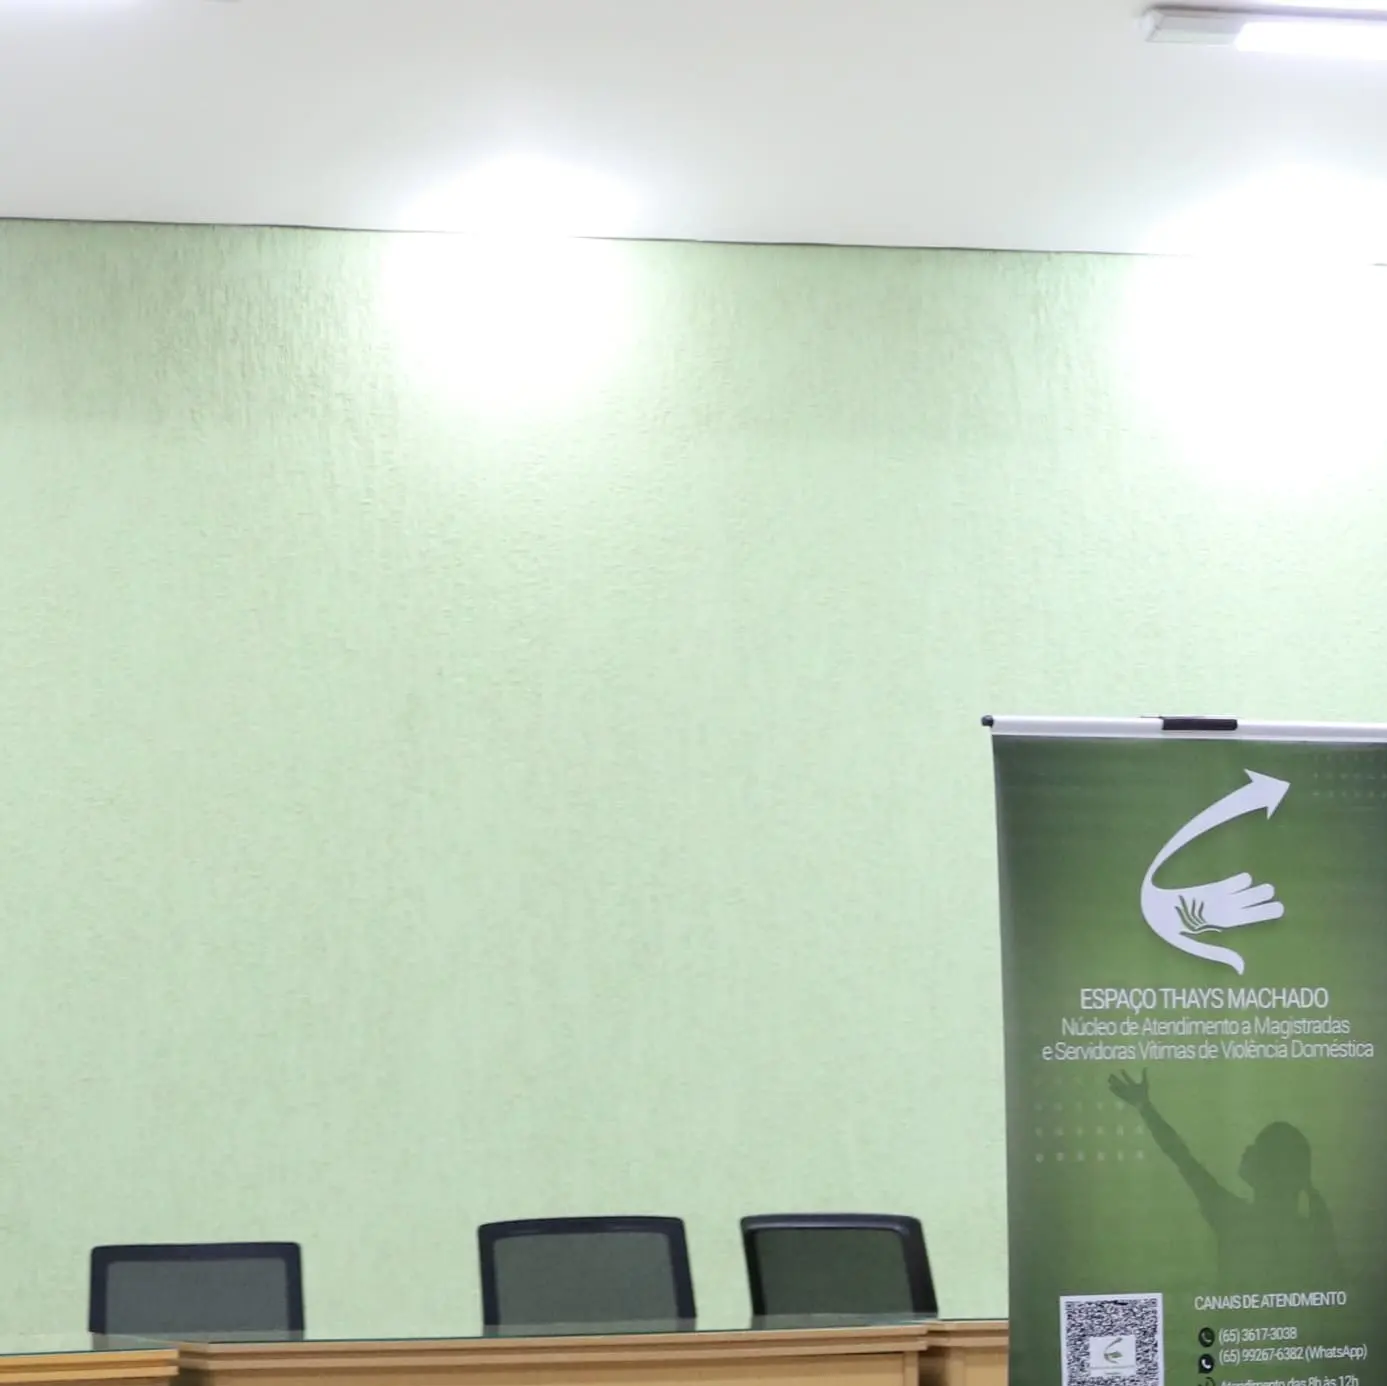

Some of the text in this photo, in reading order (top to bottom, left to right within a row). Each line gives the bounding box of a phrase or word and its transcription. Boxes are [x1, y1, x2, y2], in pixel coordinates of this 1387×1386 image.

[1080, 987, 1329, 1014] ESPAÇO THAYS MACHADO
[1061, 1016, 1351, 1040] Núcleo de Atendimento a Magistradas
[1042, 1039, 1374, 1061] e Servidoras Vítimas de Violência Doméstica
[1194, 1294, 1242, 1311] CANAIS
[1243, 1294, 1260, 1309] DE
[1218, 1328, 1240, 1345] (65)
[1219, 1348, 1241, 1366] (65)
[1305, 1342, 1368, 1362] (WhatsApp)
